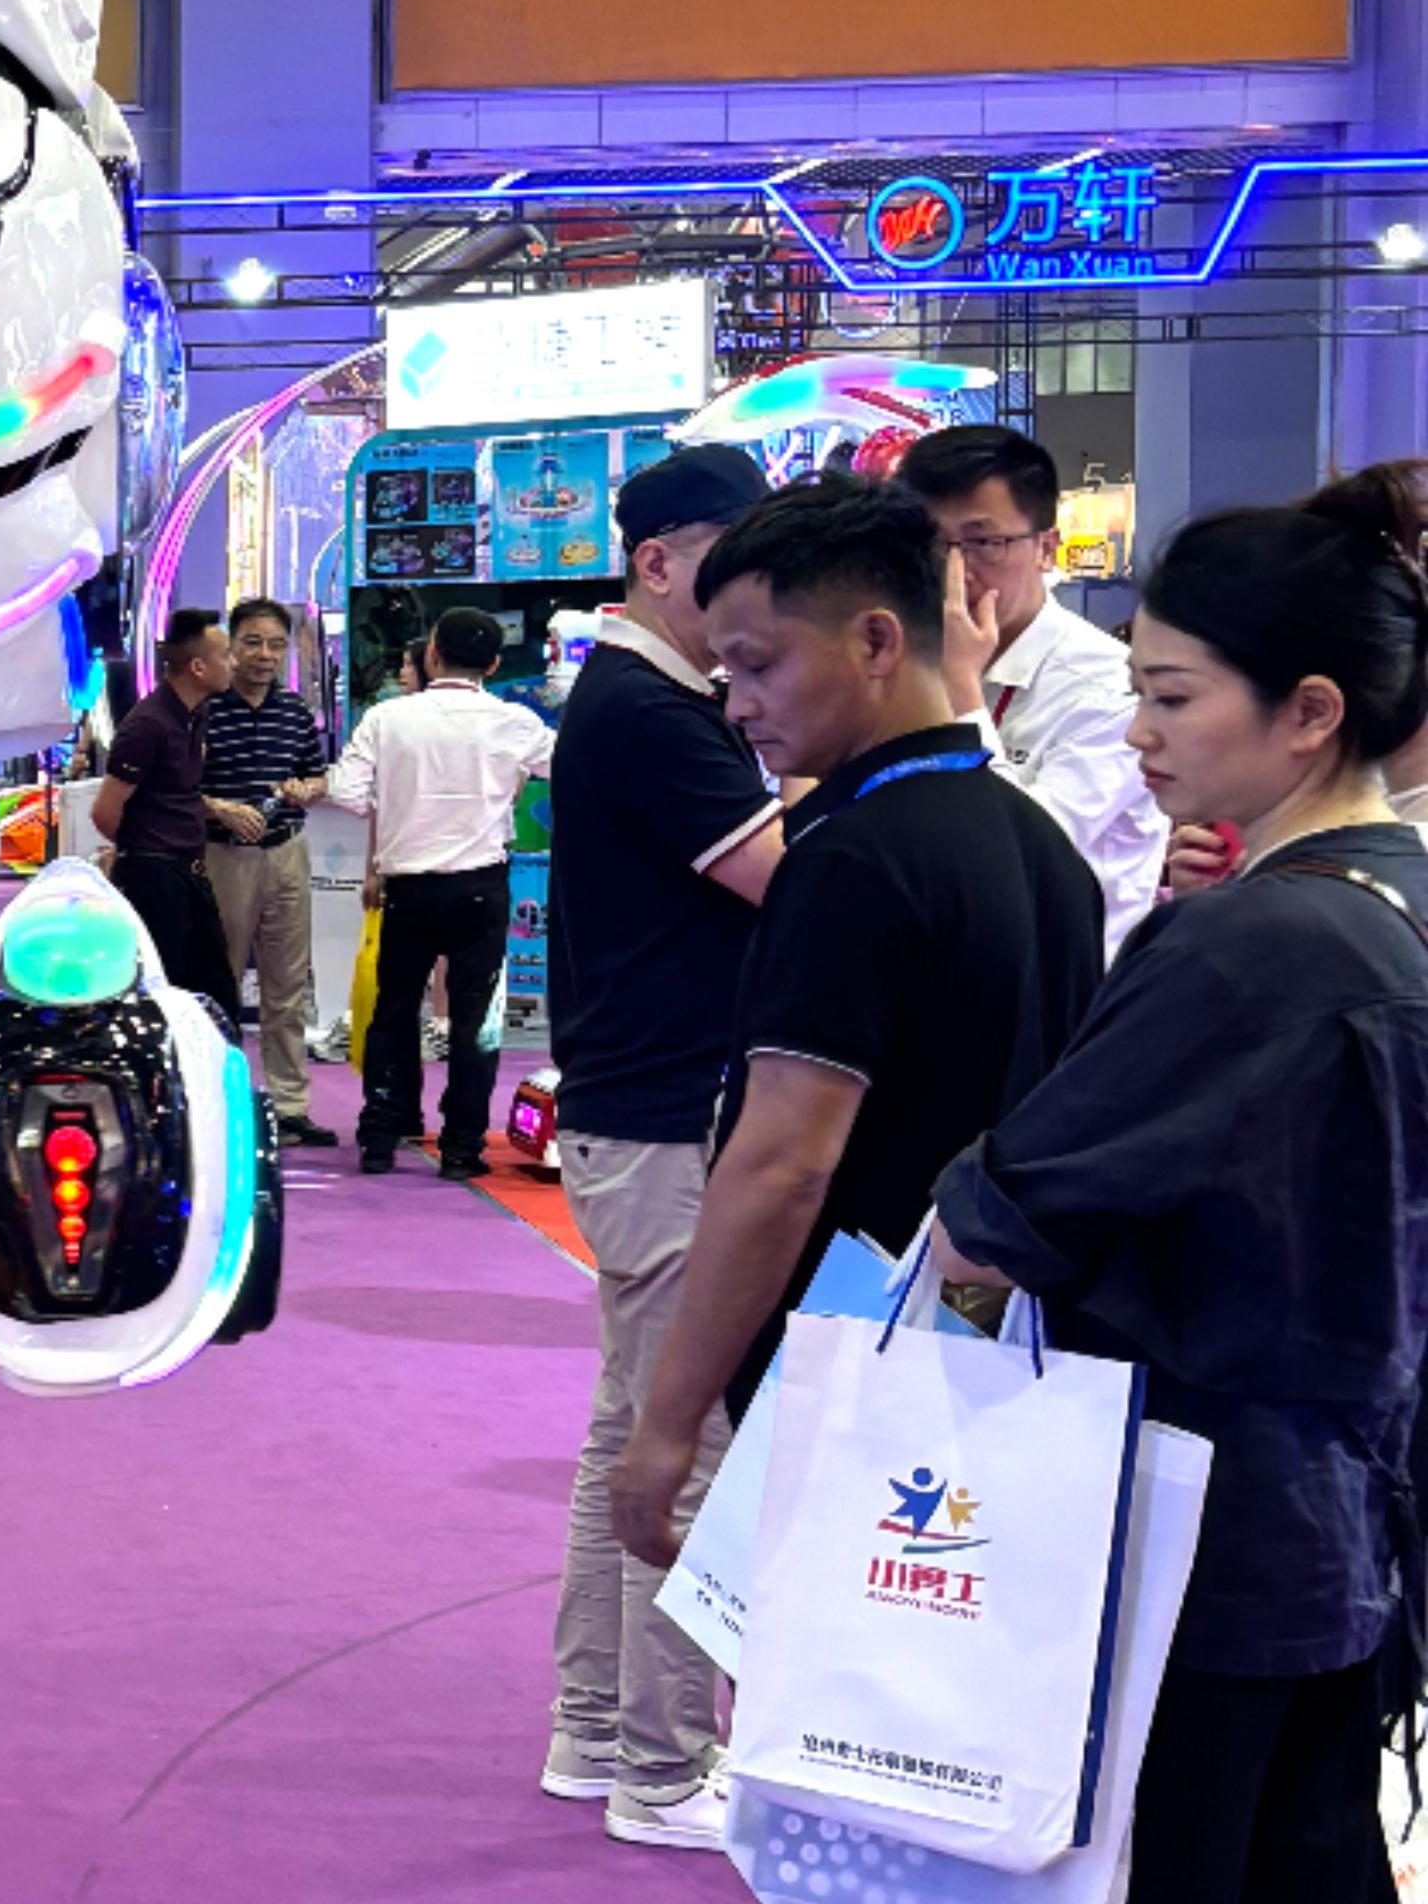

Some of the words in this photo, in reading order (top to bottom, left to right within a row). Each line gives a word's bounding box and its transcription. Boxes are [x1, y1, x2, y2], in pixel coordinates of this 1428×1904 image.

[986, 162, 1157, 244] 万轩
[987, 252, 1061, 280] Wan
[1068, 250, 1153, 279] Xuan
